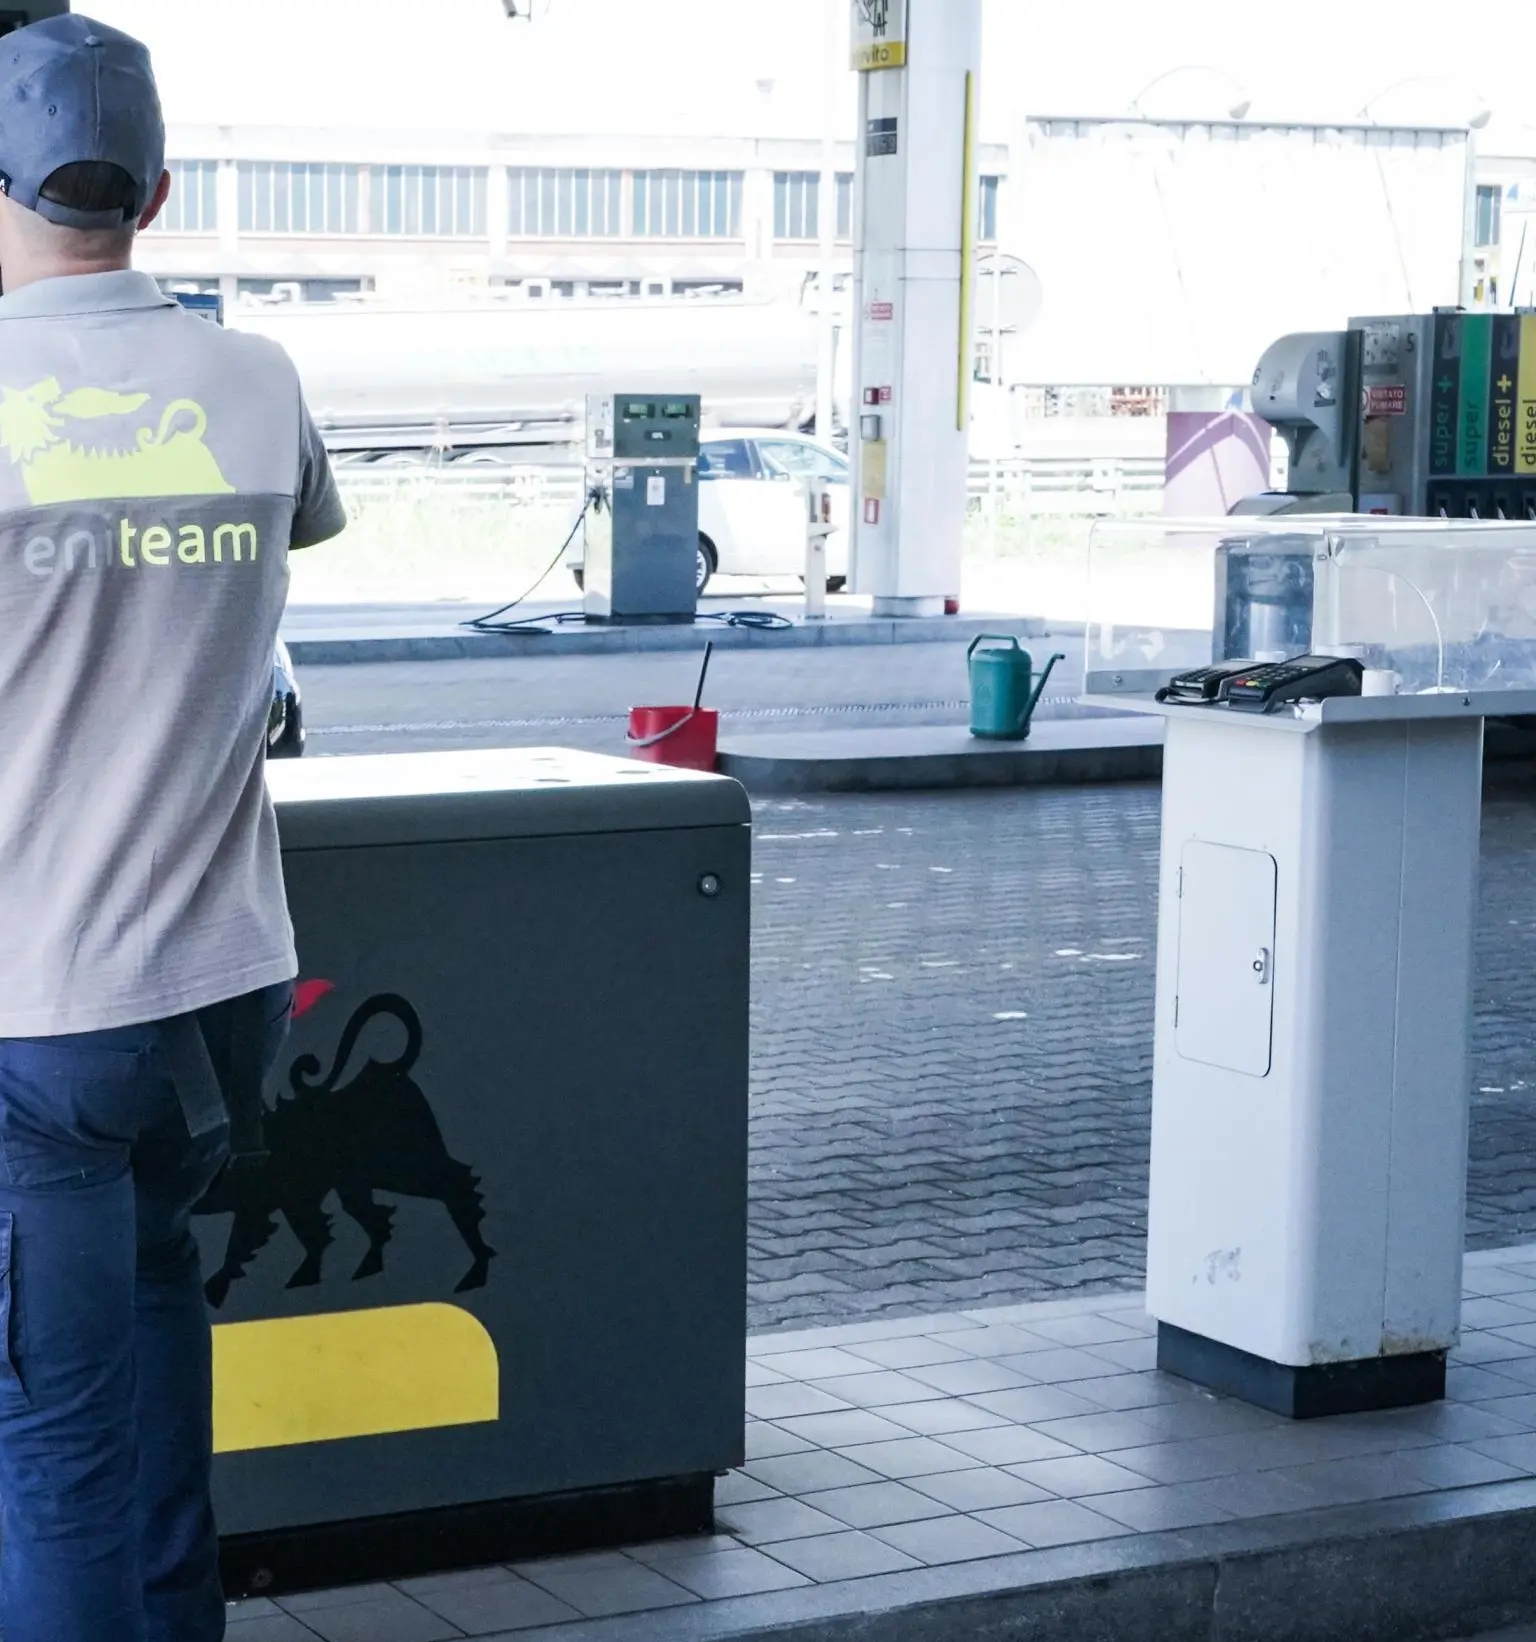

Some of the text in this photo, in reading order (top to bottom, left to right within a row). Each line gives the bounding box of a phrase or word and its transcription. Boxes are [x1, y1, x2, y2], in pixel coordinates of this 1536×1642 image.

[1406, 332, 1415, 352] 5
[1435, 401, 1452, 468] super
[1465, 400, 1483, 469] super
[1492, 399, 1512, 466] diesel
[119, 518, 257, 567] team
